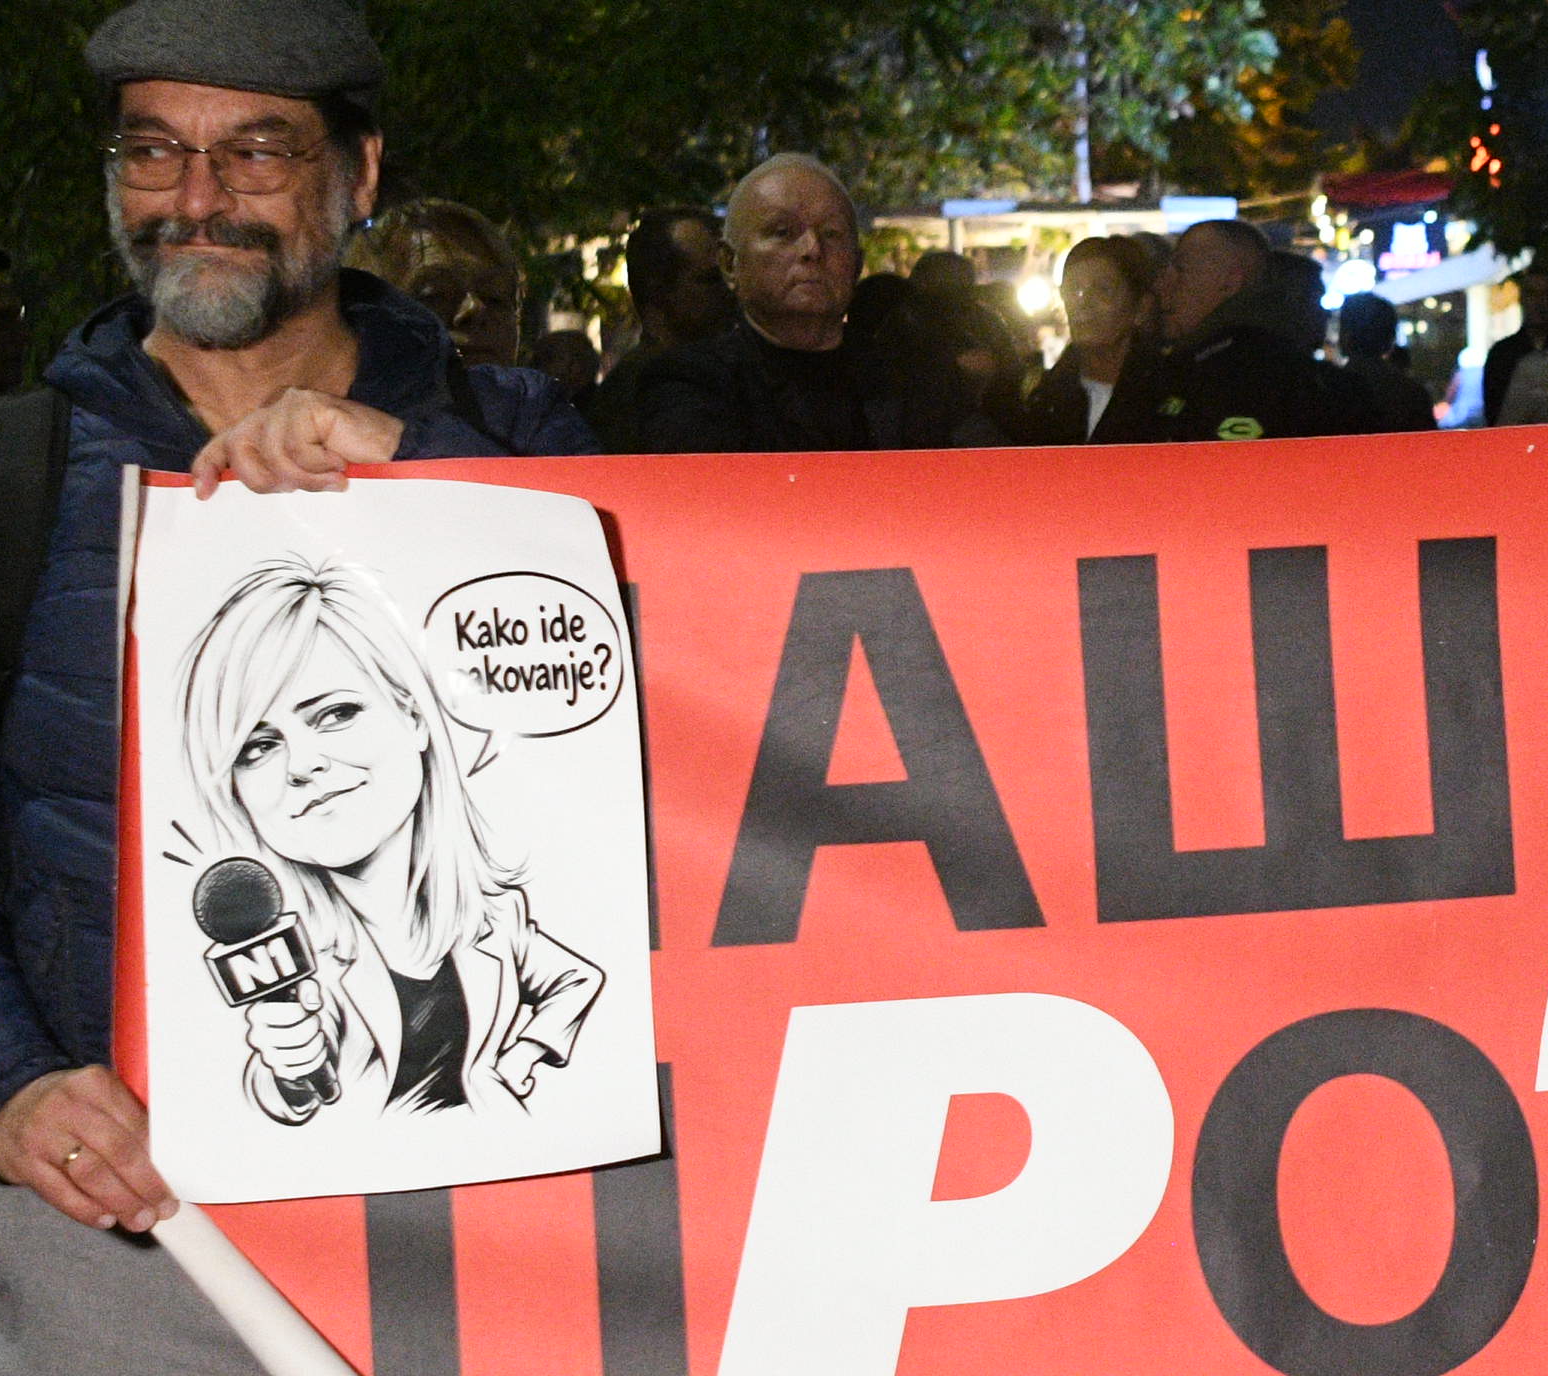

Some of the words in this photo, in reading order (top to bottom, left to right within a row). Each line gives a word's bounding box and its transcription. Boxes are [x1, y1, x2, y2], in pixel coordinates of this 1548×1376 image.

[455, 607, 529, 652] Kako
[539, 603, 587, 643] ide
[623, 536, 1517, 951] АШ
[227, 936, 298, 994] N1
